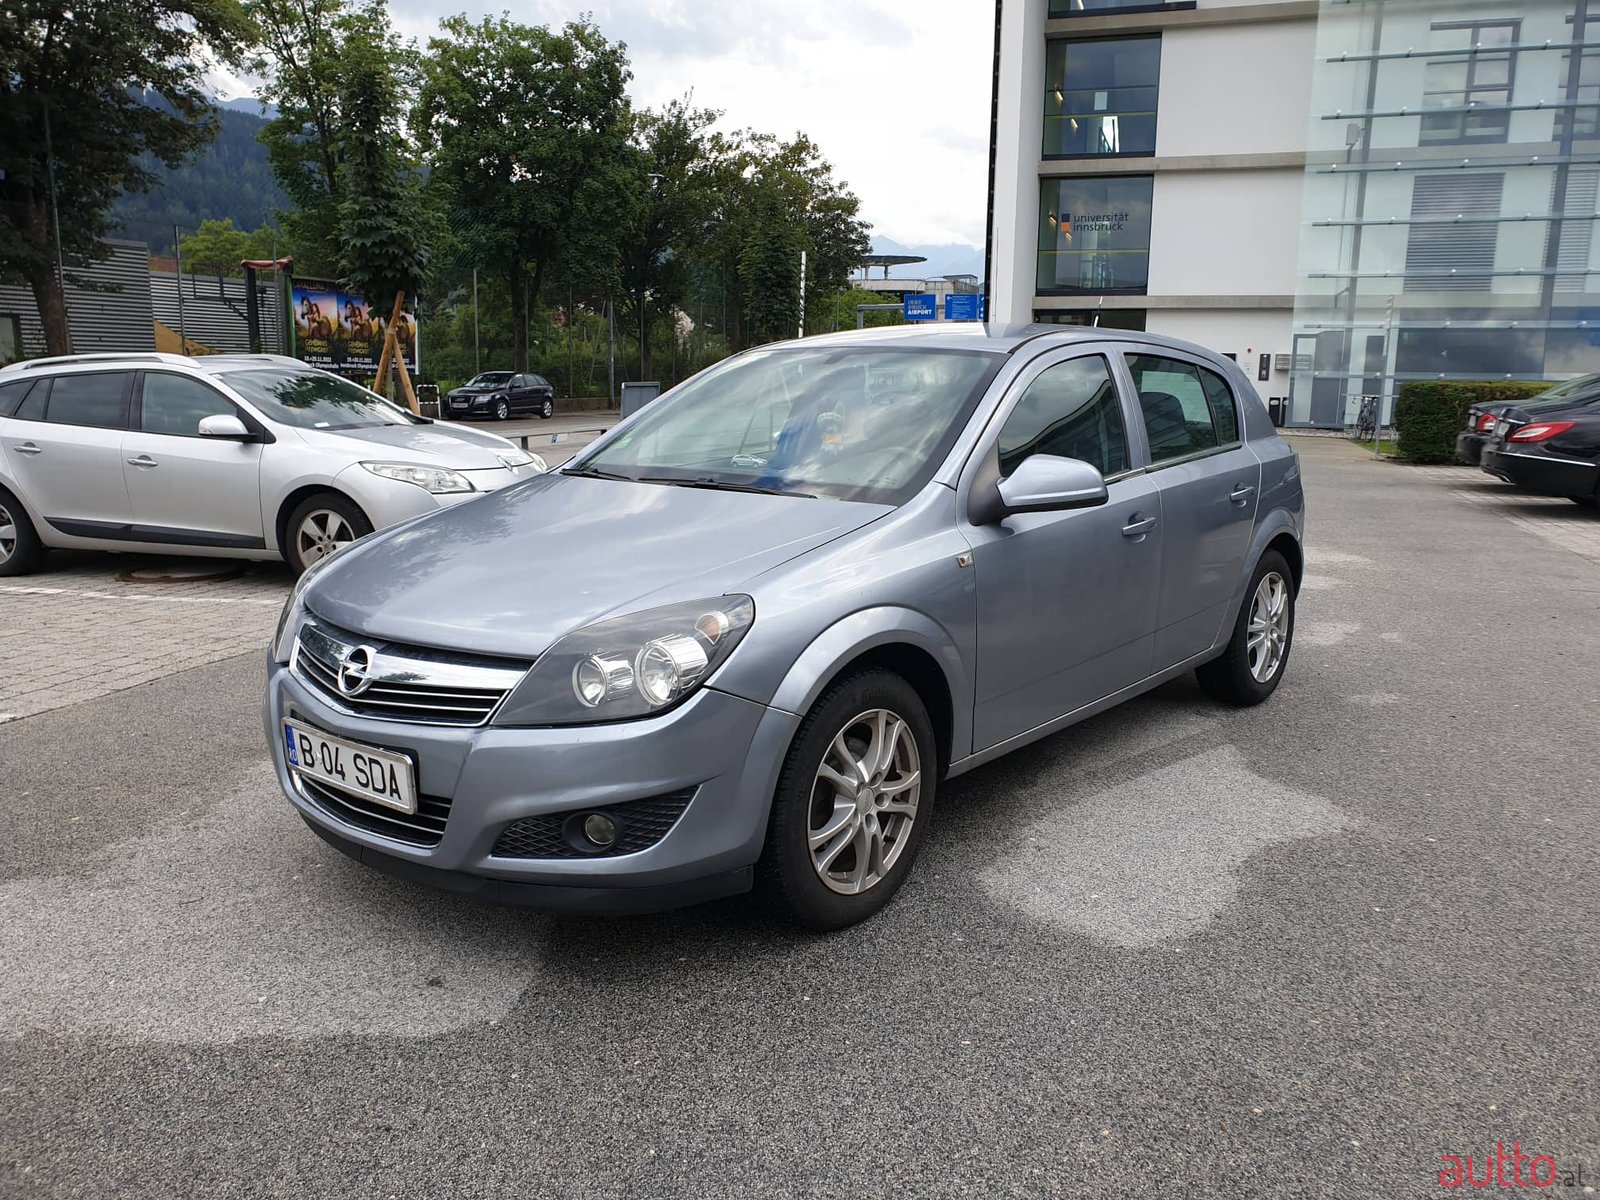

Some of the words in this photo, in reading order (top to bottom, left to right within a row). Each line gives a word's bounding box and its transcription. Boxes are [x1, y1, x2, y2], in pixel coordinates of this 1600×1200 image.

[1073, 213, 1129, 222] universität
[1073, 222, 1123, 231] innsbruck
[299, 733, 315, 768] B
[320, 741, 346, 781] 04
[353, 752, 402, 800] SDA
